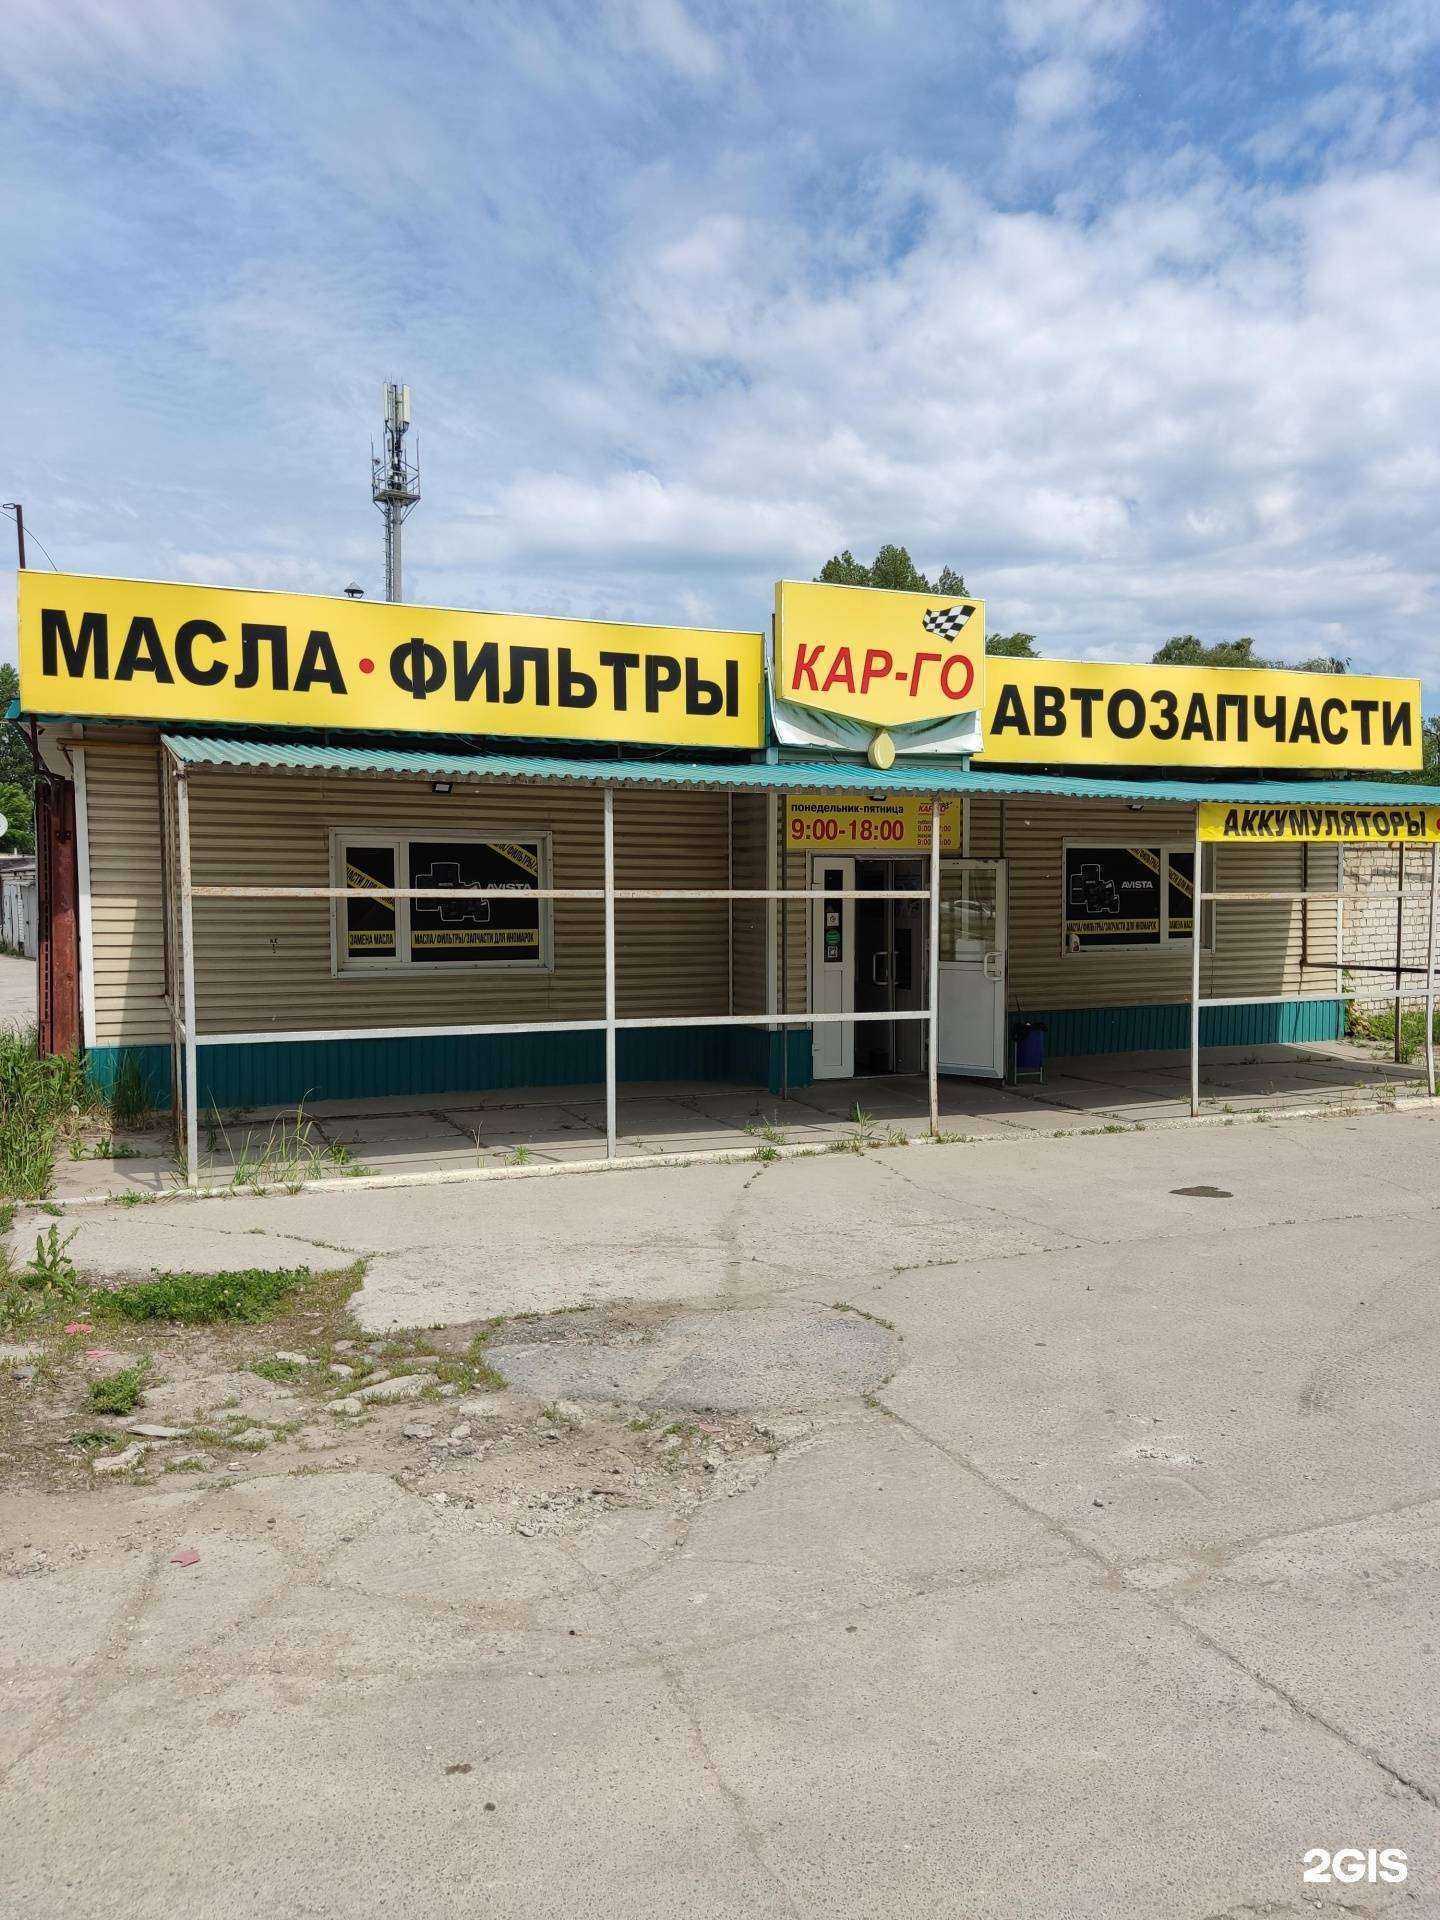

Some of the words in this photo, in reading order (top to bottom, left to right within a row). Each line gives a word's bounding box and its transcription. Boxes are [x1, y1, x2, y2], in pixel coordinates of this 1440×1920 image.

[41, 608, 347, 695] МАСЛА
[389, 637, 739, 717] ФИЛЬТРЫ
[792, 643, 975, 700] КАР-ГО
[990, 683, 1412, 747] АВТОЗАПЧАСТИ
[791, 804, 904, 815] понедельник-пятница
[1223, 808, 1426, 837] АККУМУЛЯТОРЫ
[791, 818, 905, 841] 9:00-18:00
[1121, 881, 1153, 889] AVISTA
